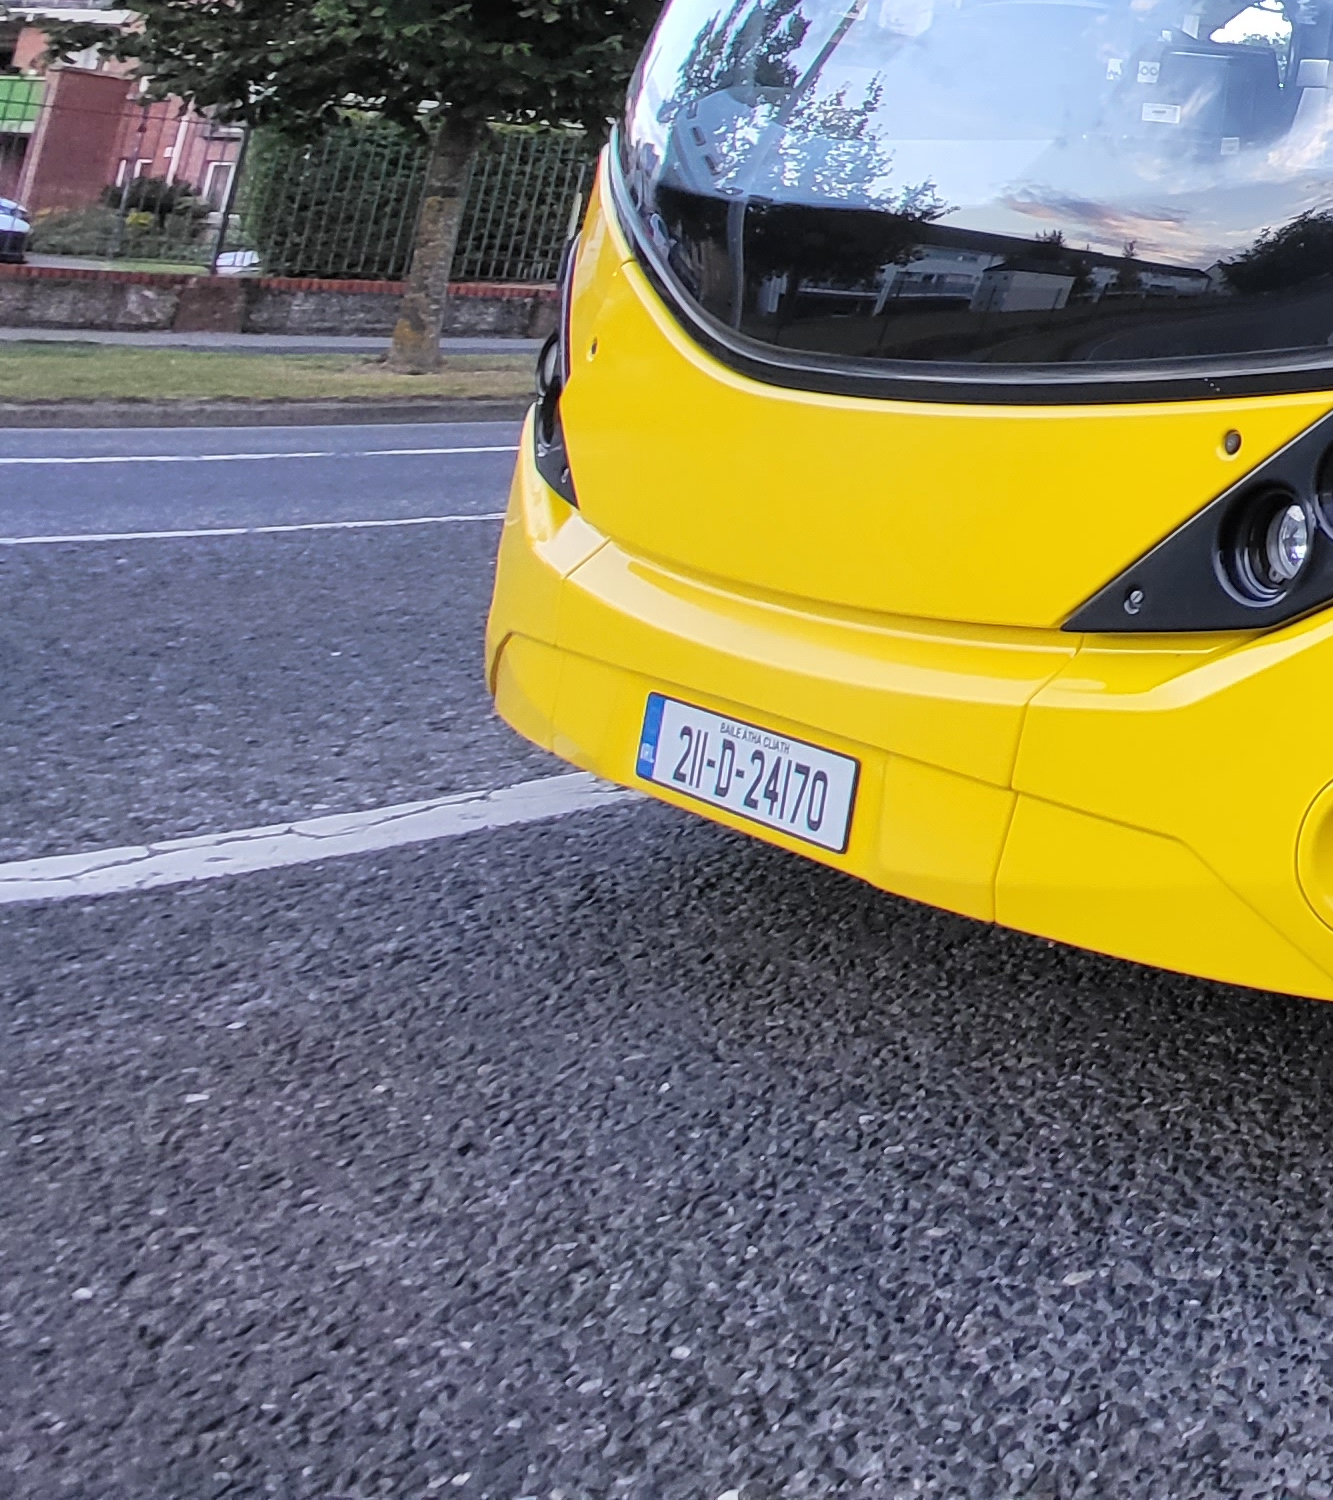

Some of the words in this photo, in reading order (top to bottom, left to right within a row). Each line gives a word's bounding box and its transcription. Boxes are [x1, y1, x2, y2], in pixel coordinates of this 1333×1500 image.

[720, 722, 742, 739] BAILE
[763, 737, 791, 754] CLIATH
[672, 725, 829, 832] 211-D-24170
